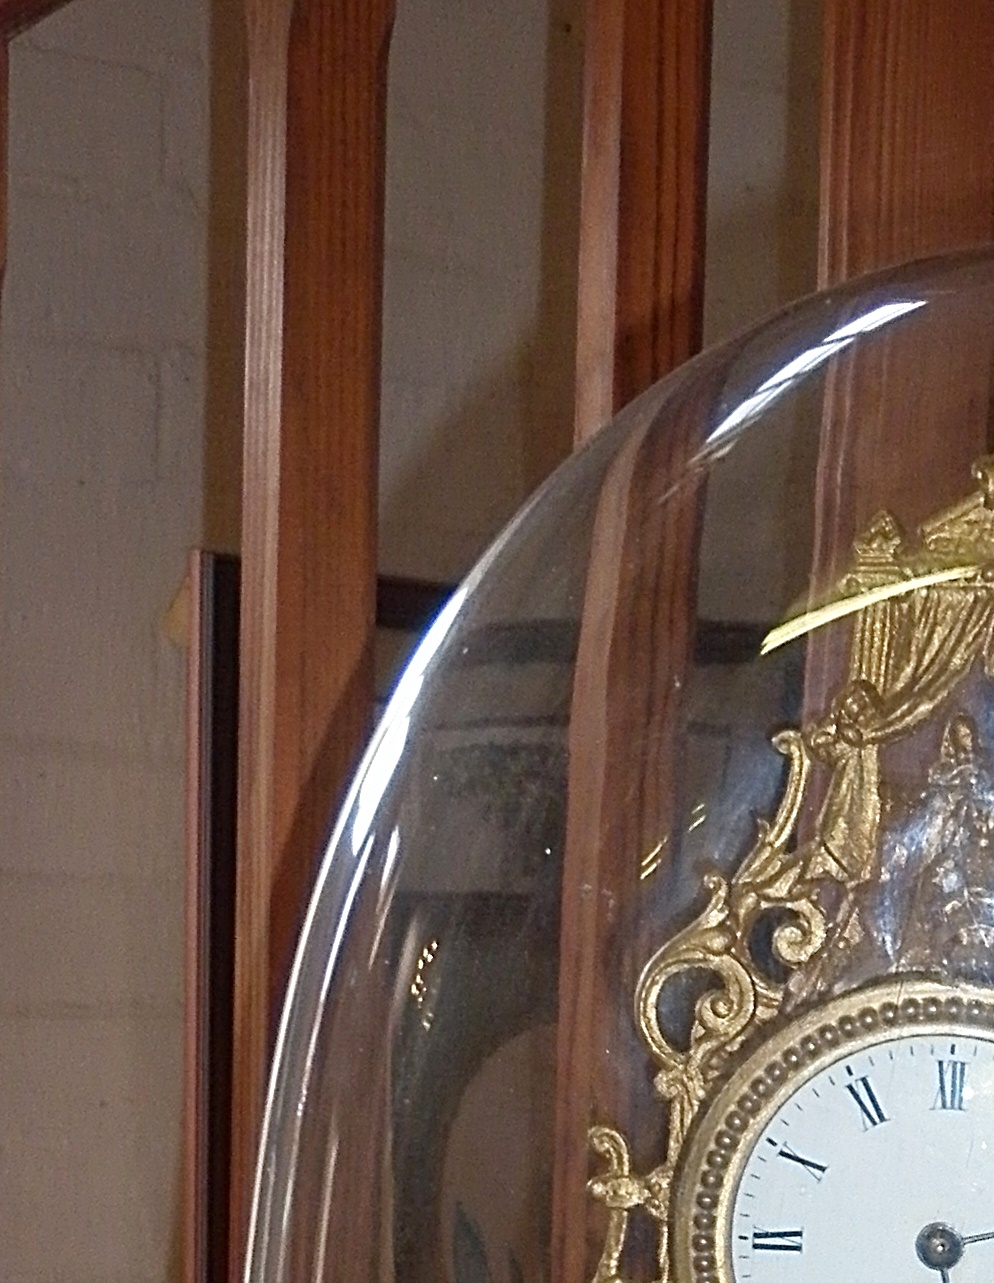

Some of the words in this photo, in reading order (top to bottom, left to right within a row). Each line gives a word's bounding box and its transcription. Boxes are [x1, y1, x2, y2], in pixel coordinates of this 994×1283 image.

[847, 1076, 891, 1132] XI
[931, 1060, 971, 1110] XII
[778, 1142, 829, 1182] X
[752, 1227, 803, 1253] IX
